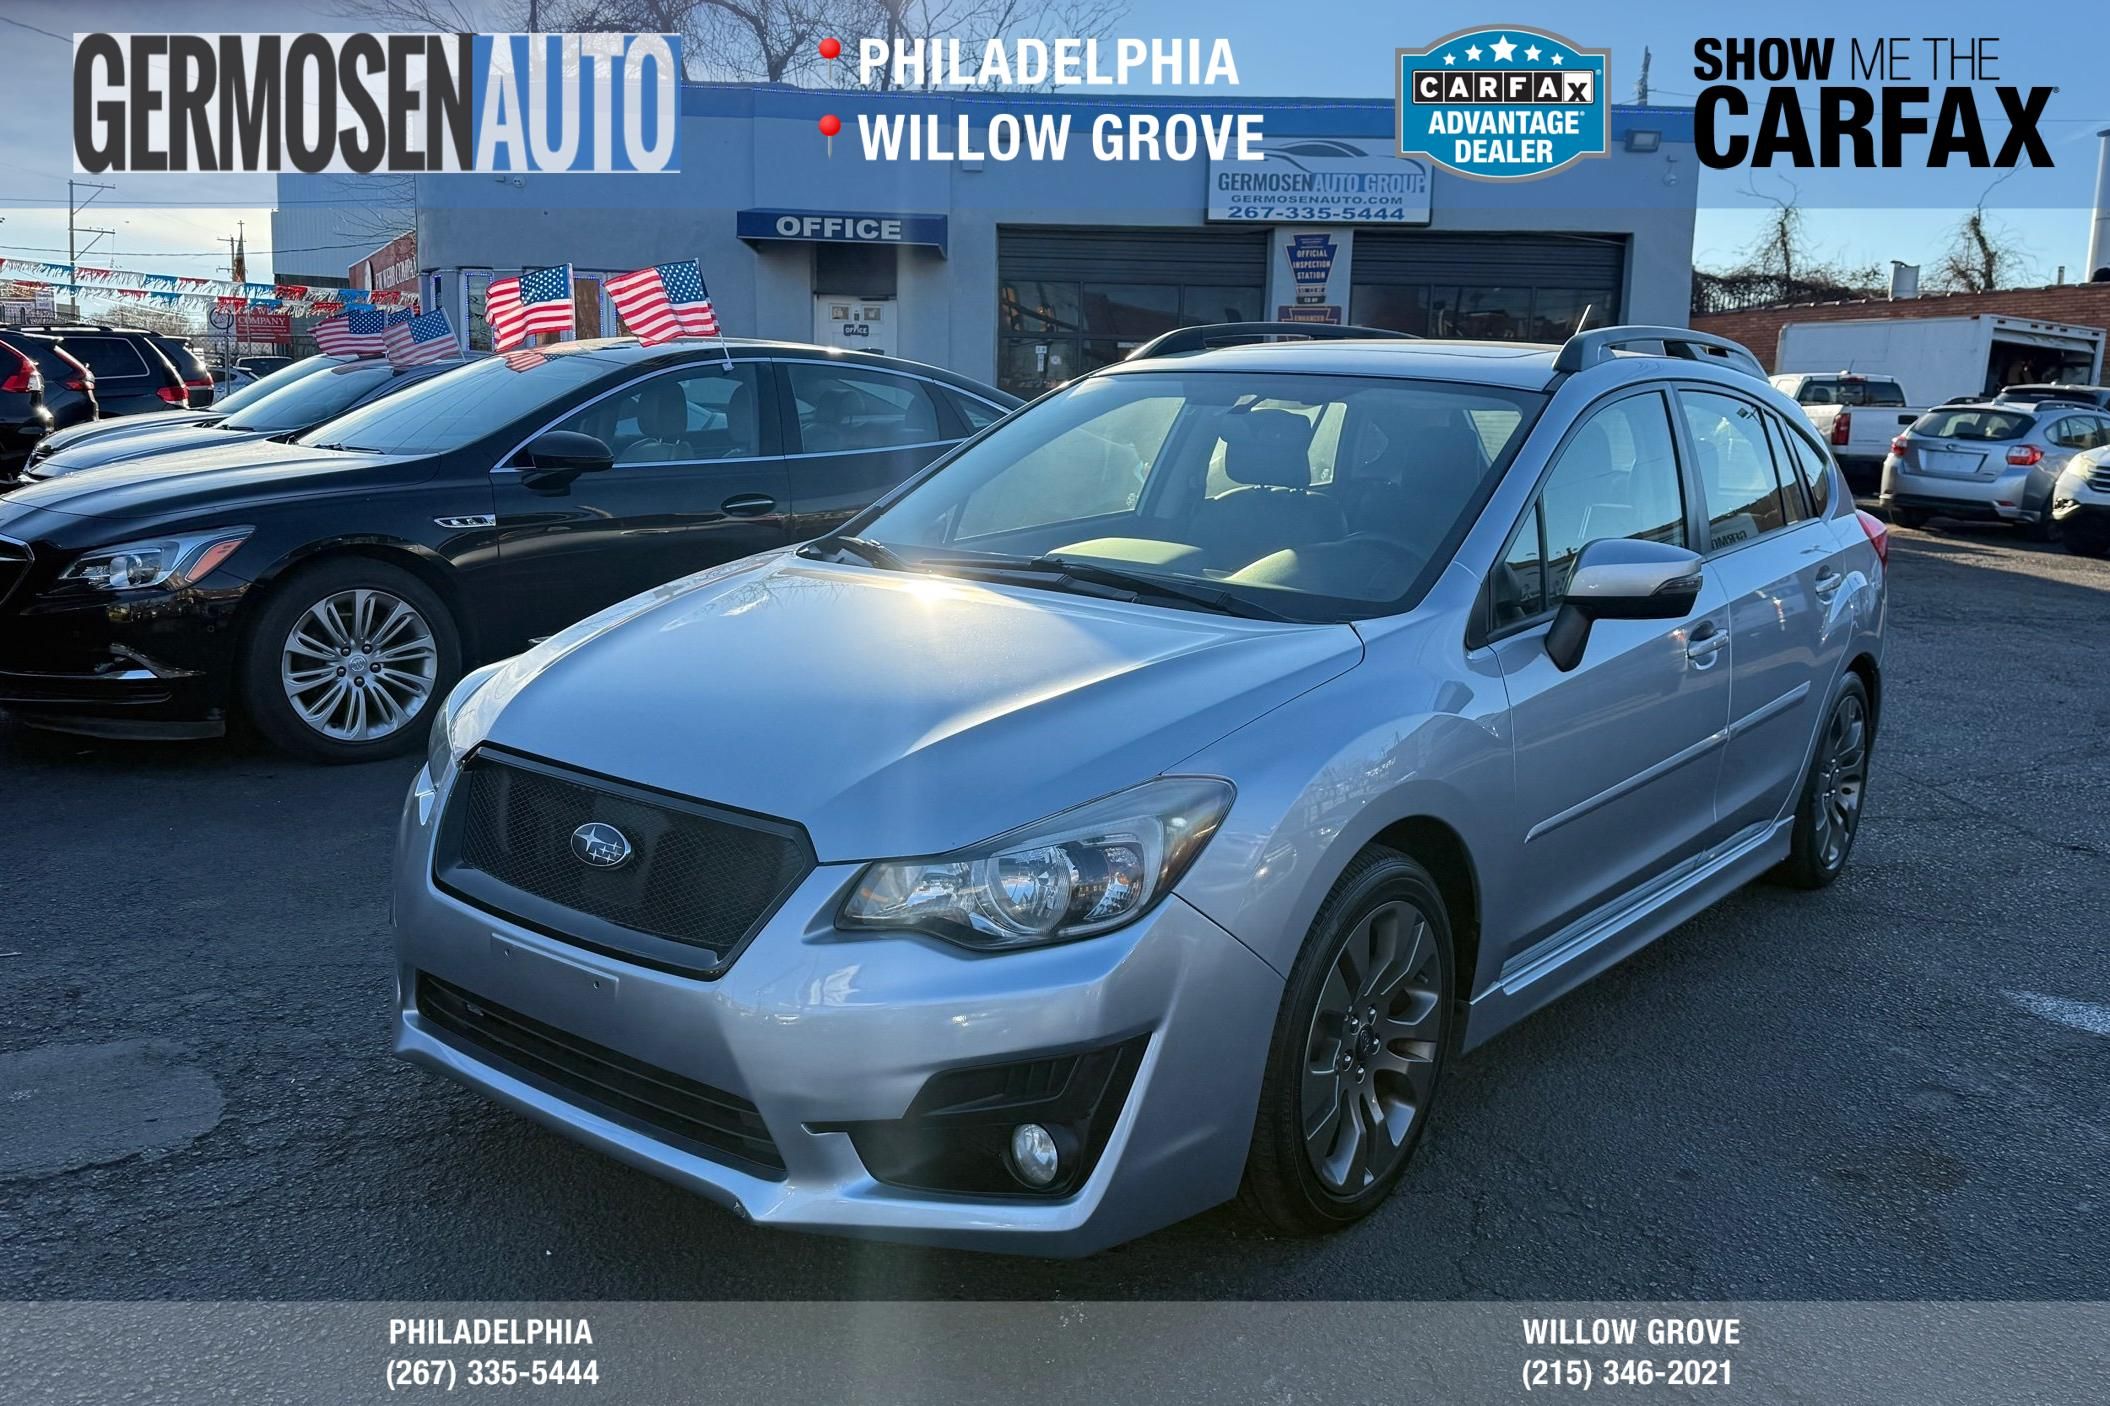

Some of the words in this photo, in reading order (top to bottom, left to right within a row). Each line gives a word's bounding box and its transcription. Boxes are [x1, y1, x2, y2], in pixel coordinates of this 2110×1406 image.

[1361, 173, 1426, 194] GROUP
[1231, 194, 1403, 205] GERMOSENAUTO.COM
[1227, 205, 1406, 220] 267-335-5444
[776, 216, 902, 240] OFFICE
[1296, 249, 1328, 258] OFFICIAL
[1292, 260, 1331, 269] INSPECTION
[1297, 271, 1326, 280] STATION
